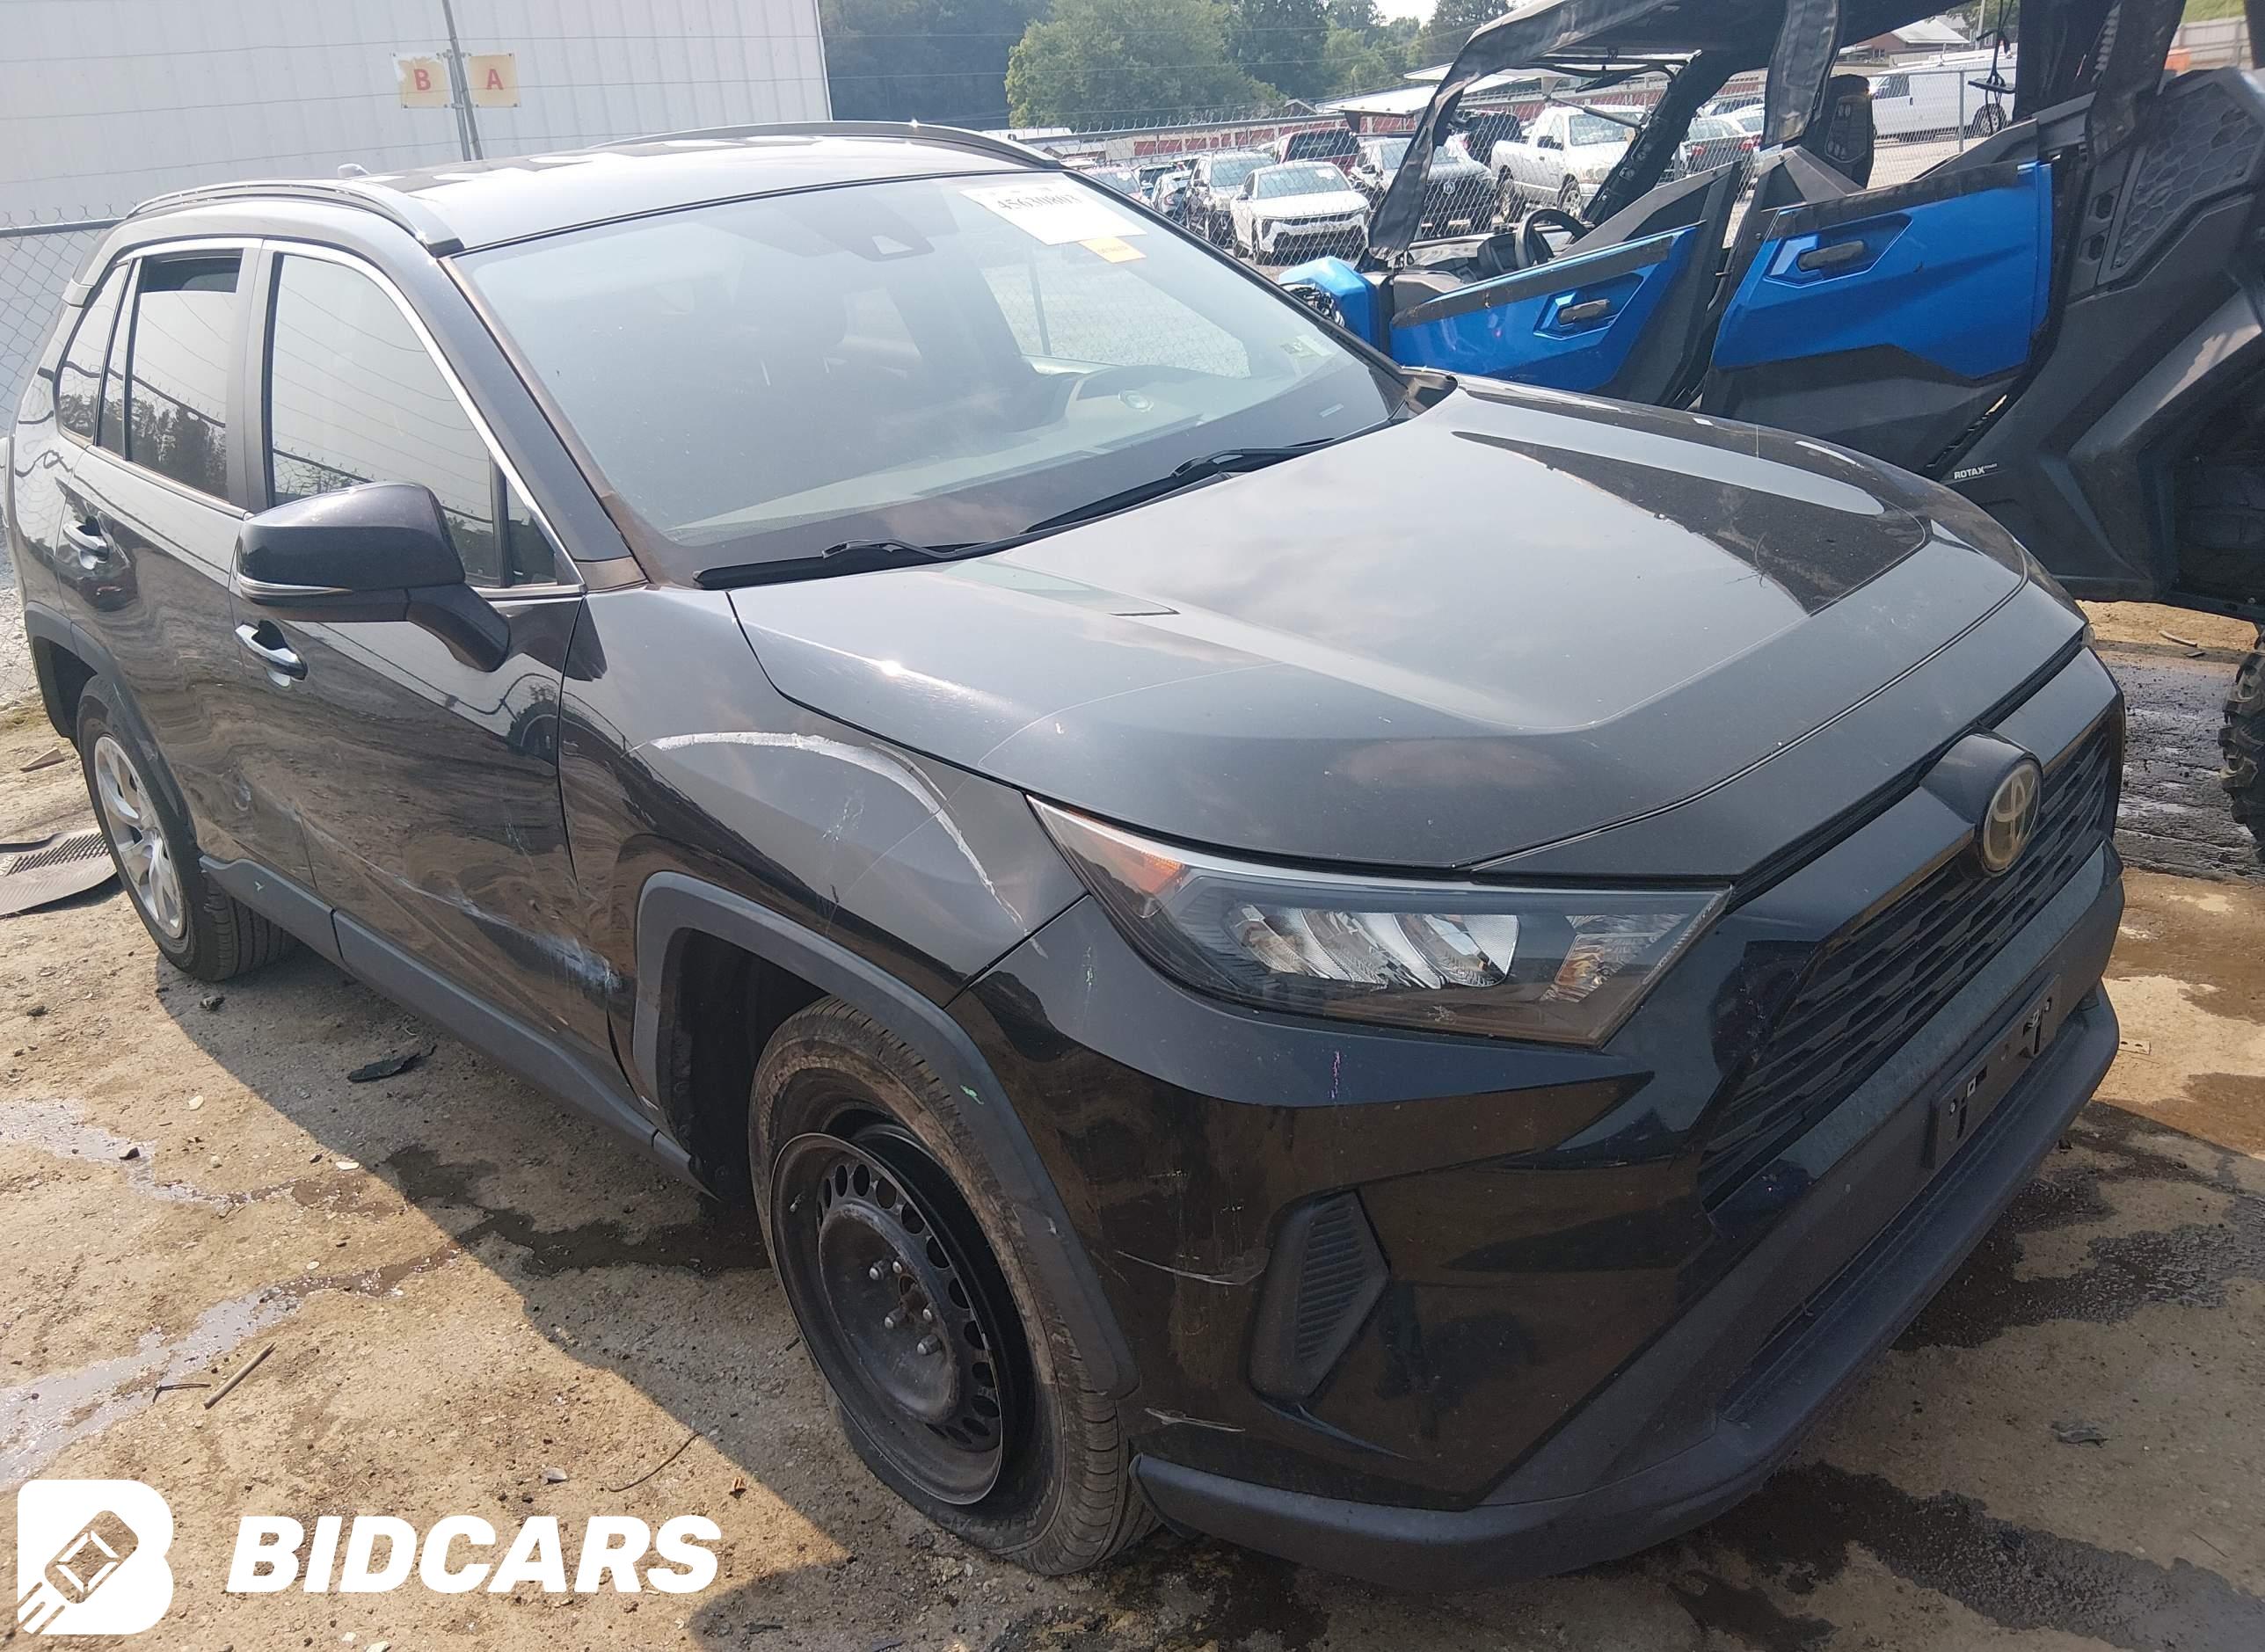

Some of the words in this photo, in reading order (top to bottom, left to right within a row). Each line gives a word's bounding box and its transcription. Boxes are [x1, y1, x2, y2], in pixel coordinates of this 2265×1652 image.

[413, 69, 431, 91] B
[485, 69, 504, 90] A
[1954, 466, 1985, 479] ROTAX
